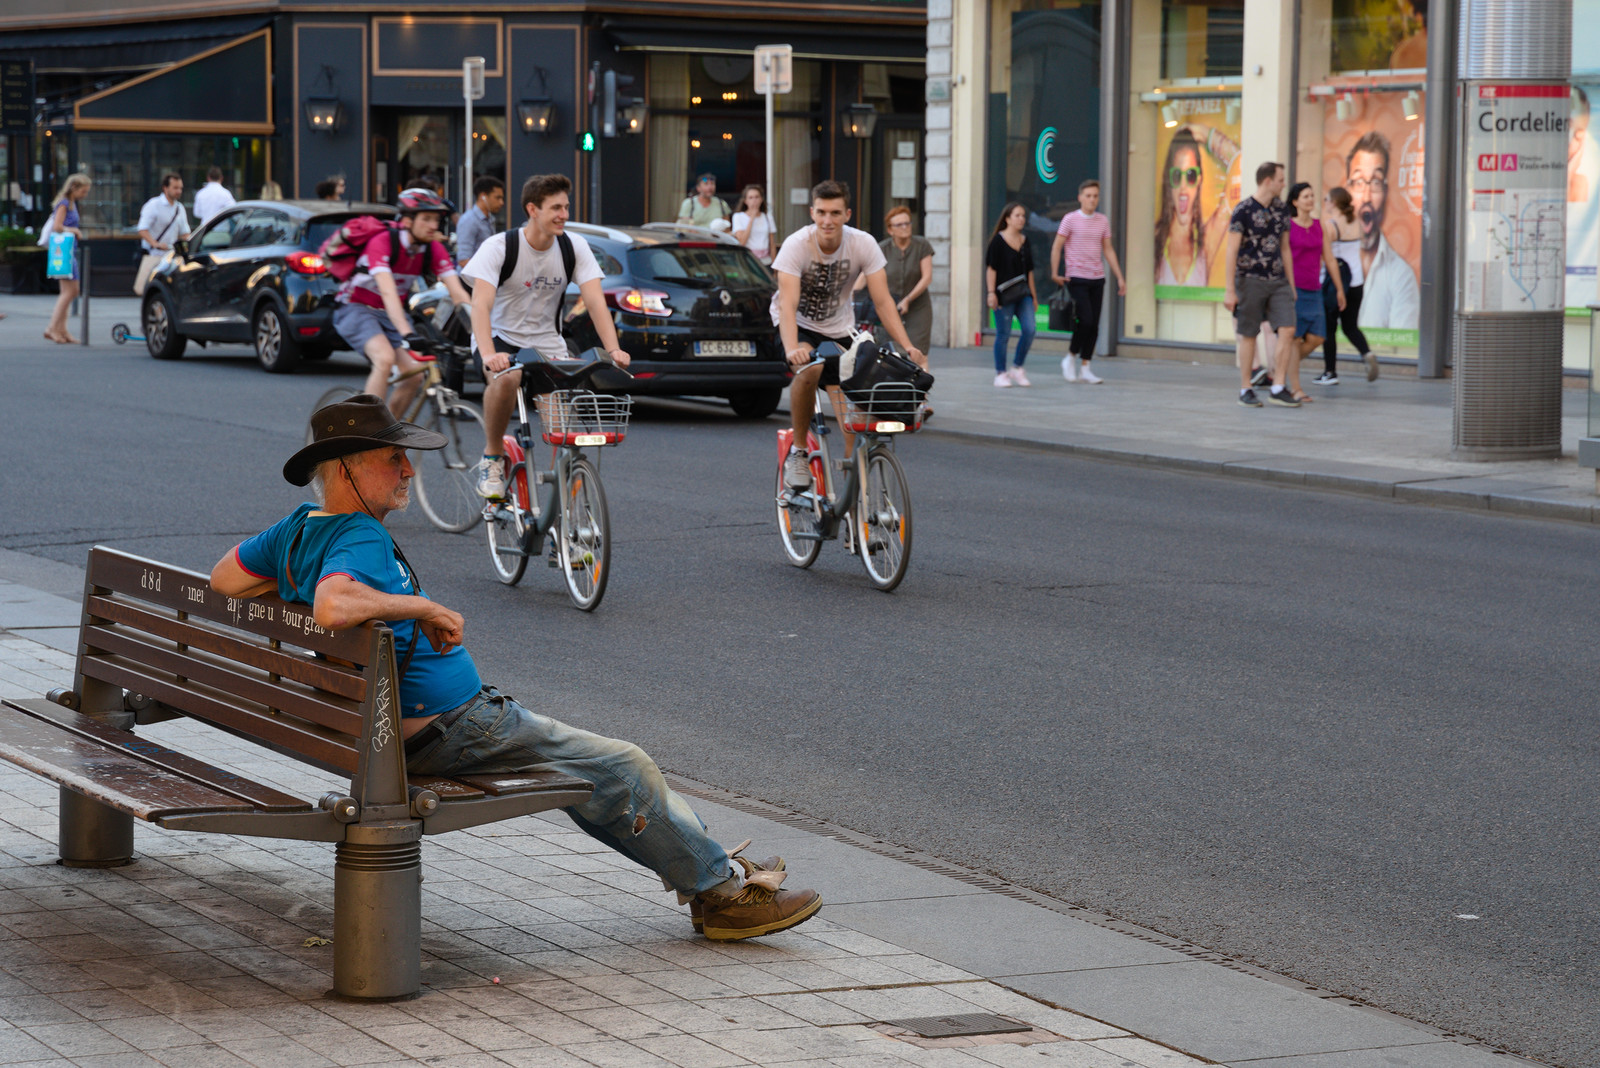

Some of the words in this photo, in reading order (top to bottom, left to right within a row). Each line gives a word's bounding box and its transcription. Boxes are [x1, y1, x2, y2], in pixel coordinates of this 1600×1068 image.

[1482, 155, 1496, 169] M
[1504, 155, 1515, 169] A
[702, 341, 749, 353] CC-632-SJ
